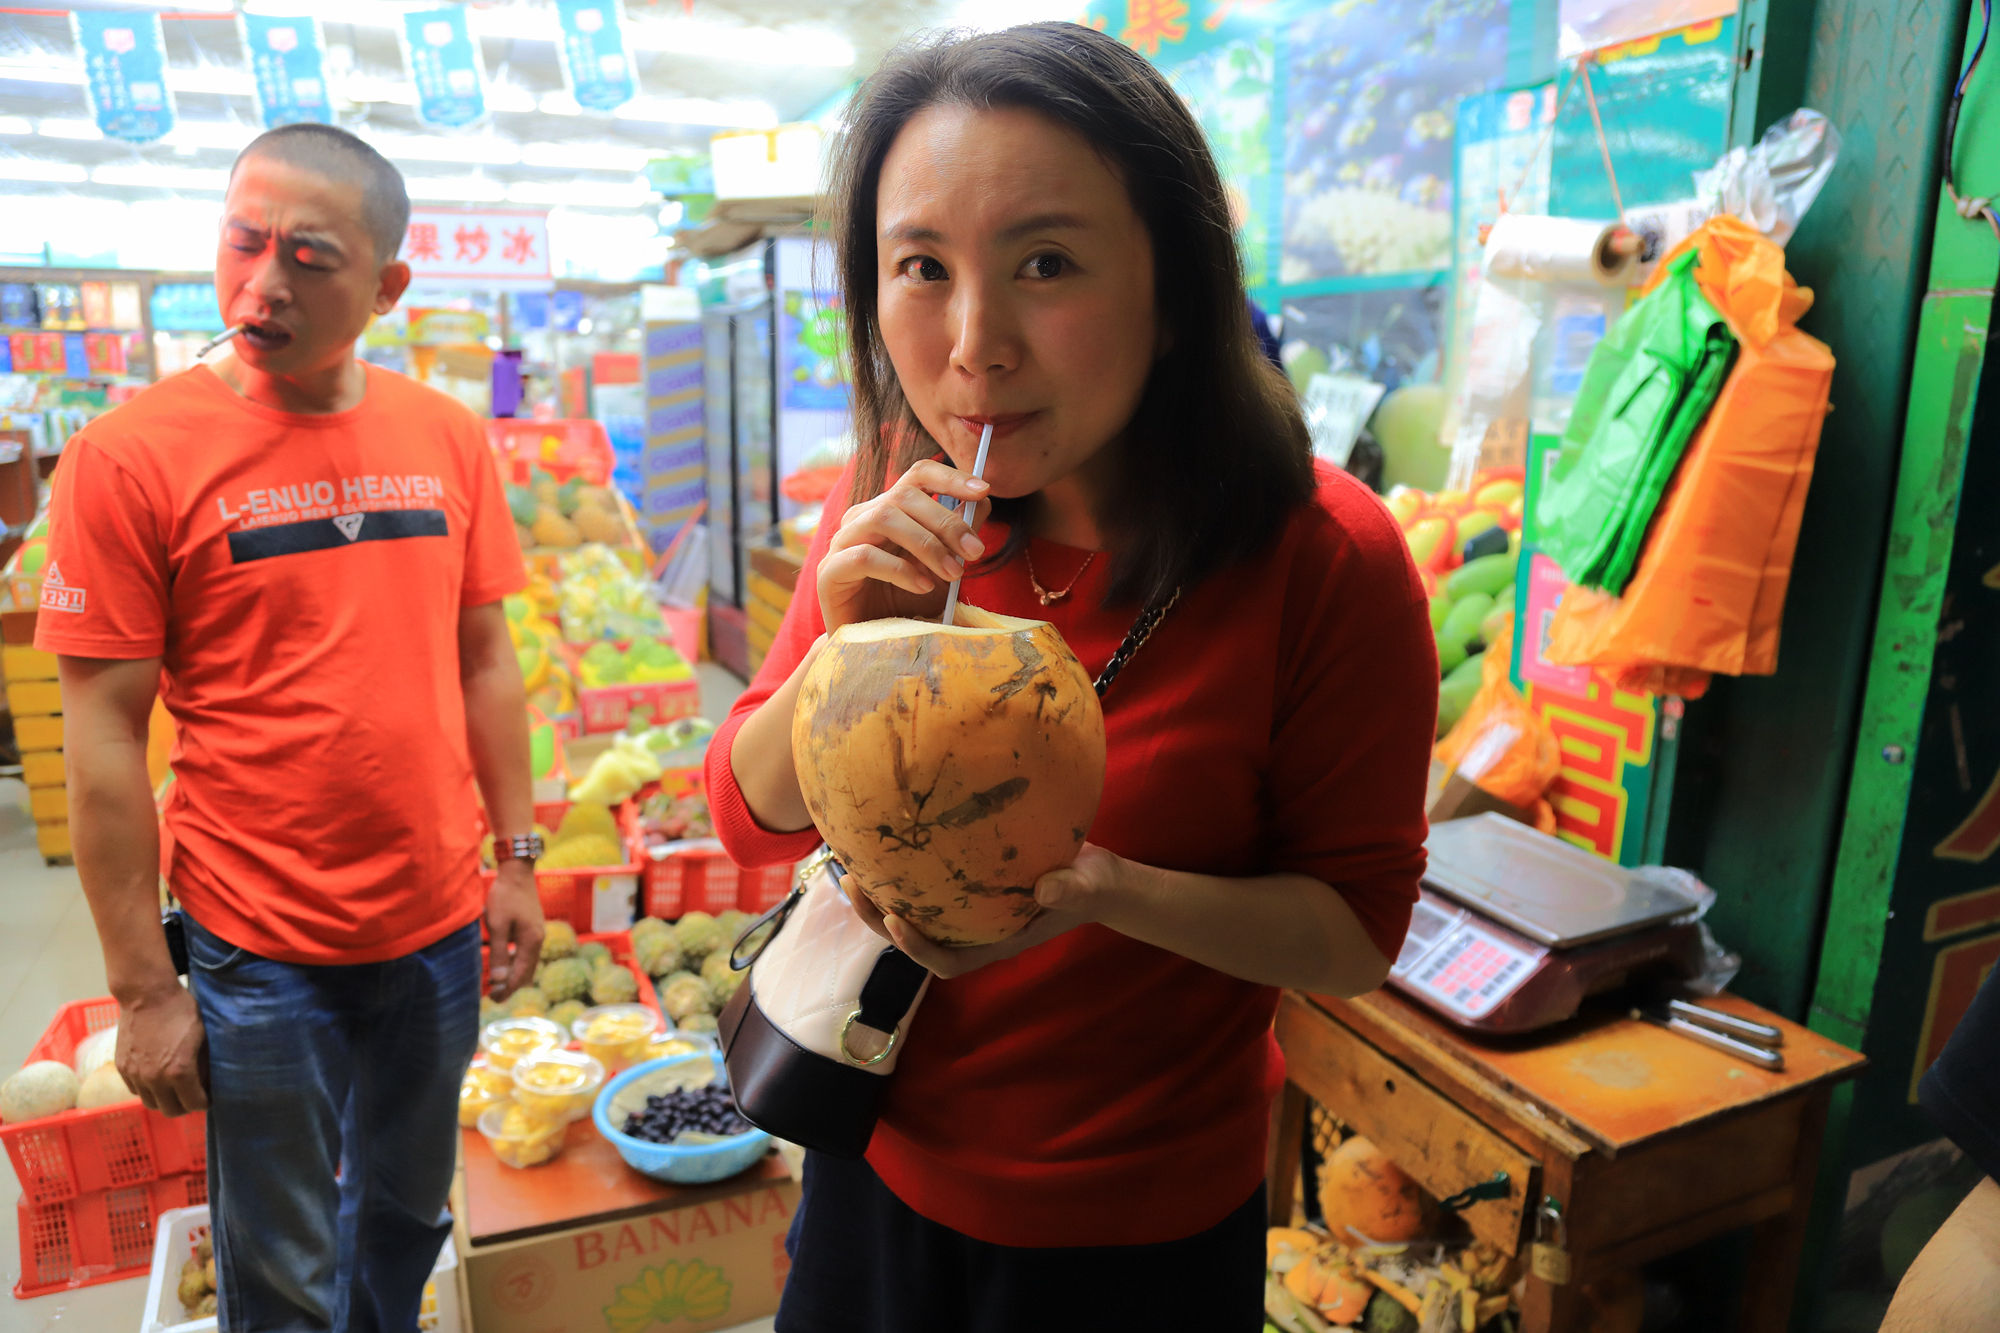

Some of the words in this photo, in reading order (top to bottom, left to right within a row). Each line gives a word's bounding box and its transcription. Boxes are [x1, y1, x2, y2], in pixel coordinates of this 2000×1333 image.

[217, 480, 335, 521] L-ENUO
[341, 475, 444, 502] HEAVEN
[572, 1187, 789, 1271] BANANA
